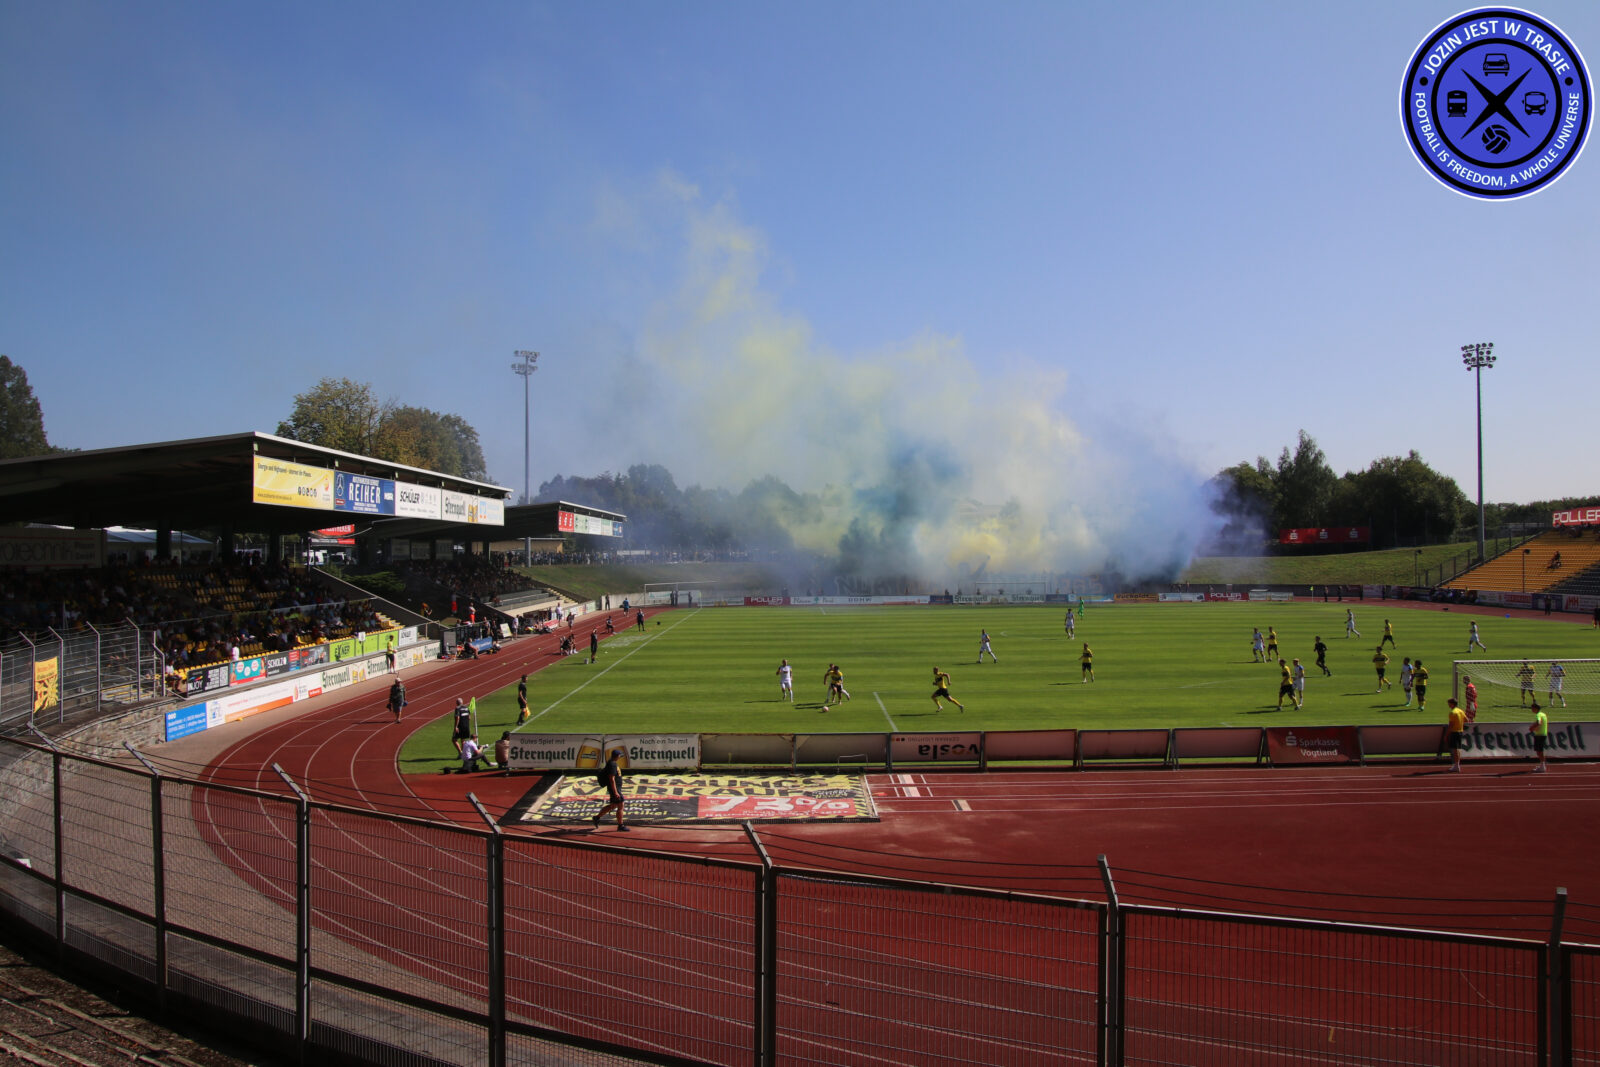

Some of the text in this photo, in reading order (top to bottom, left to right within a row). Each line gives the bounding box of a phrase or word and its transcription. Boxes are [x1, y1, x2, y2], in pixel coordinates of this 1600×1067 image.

[348, 482, 381, 505] REIHER
[400, 488, 420, 504] SCHÜLER
[322, 666, 350, 688] Sternquell
[538, 737, 554, 746] Spiel
[1299, 737, 1341, 747] Sparkasse
[510, 746, 576, 763] Sternquell
[629, 746, 696, 762] Sternquell
[1300, 748, 1338, 757] Vogtland
[704, 796, 850, 812] 73%
